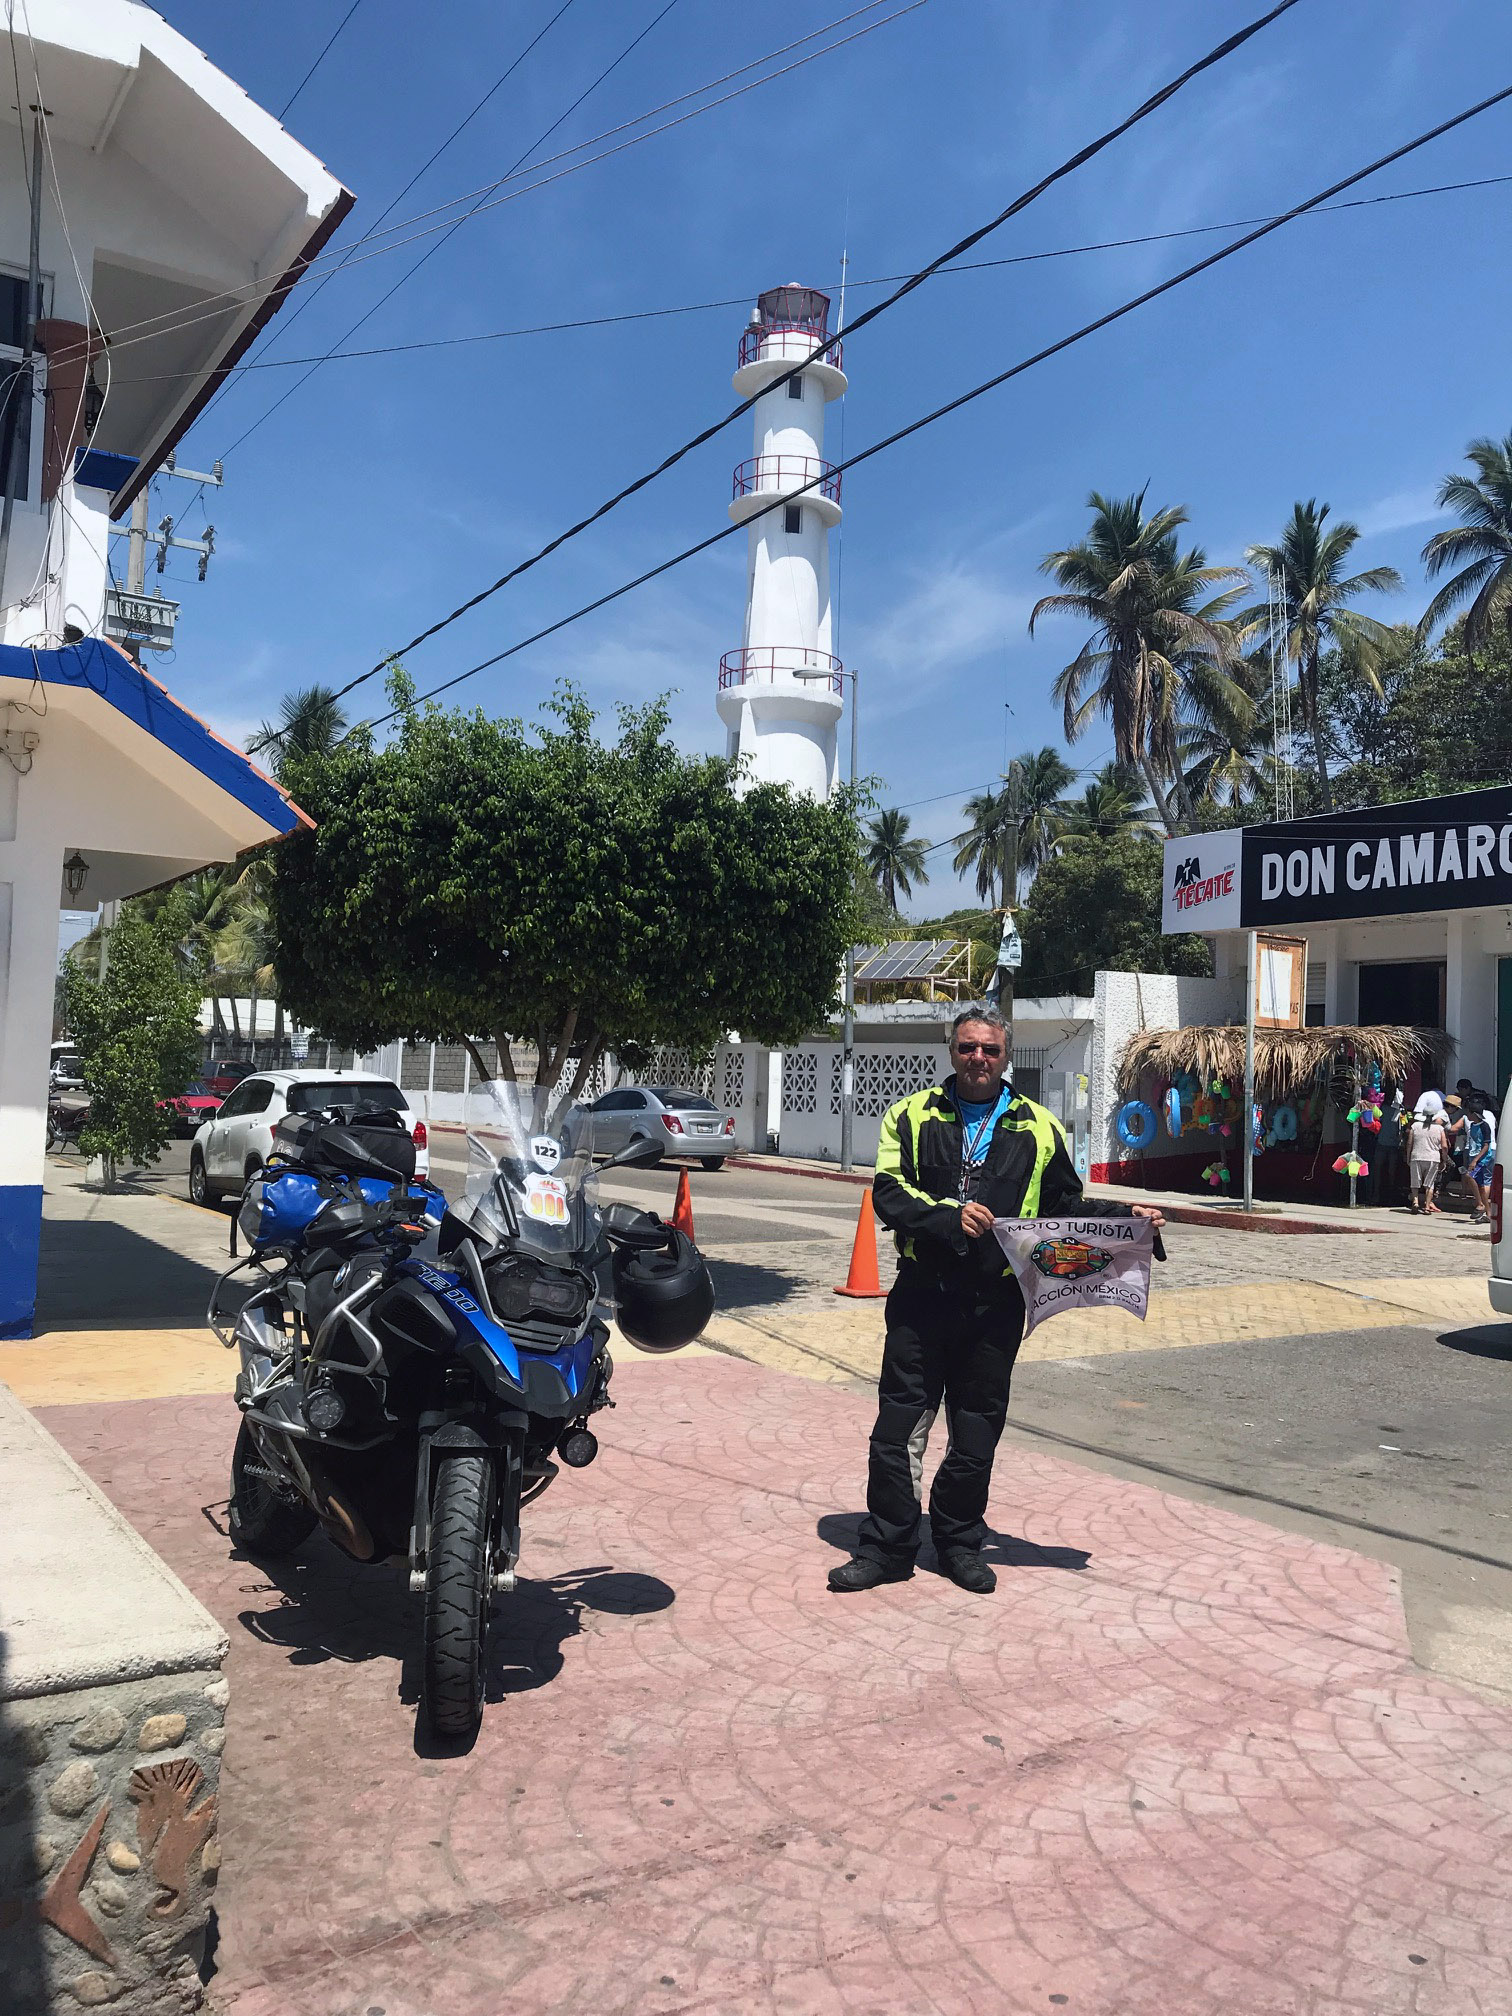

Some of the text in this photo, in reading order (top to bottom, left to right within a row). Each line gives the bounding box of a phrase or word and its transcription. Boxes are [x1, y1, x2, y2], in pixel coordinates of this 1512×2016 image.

[1261, 845, 1336, 901] DON
[1173, 870, 1234, 911] TECATE
[534, 1145, 558, 1159] 122
[1008, 1221, 1134, 1240] MOTO TURISTA
[418, 1263, 480, 1313] R1200
[1033, 1284, 1082, 1309] ACCIÓN
[1086, 1282, 1141, 1304] MÉXICO
